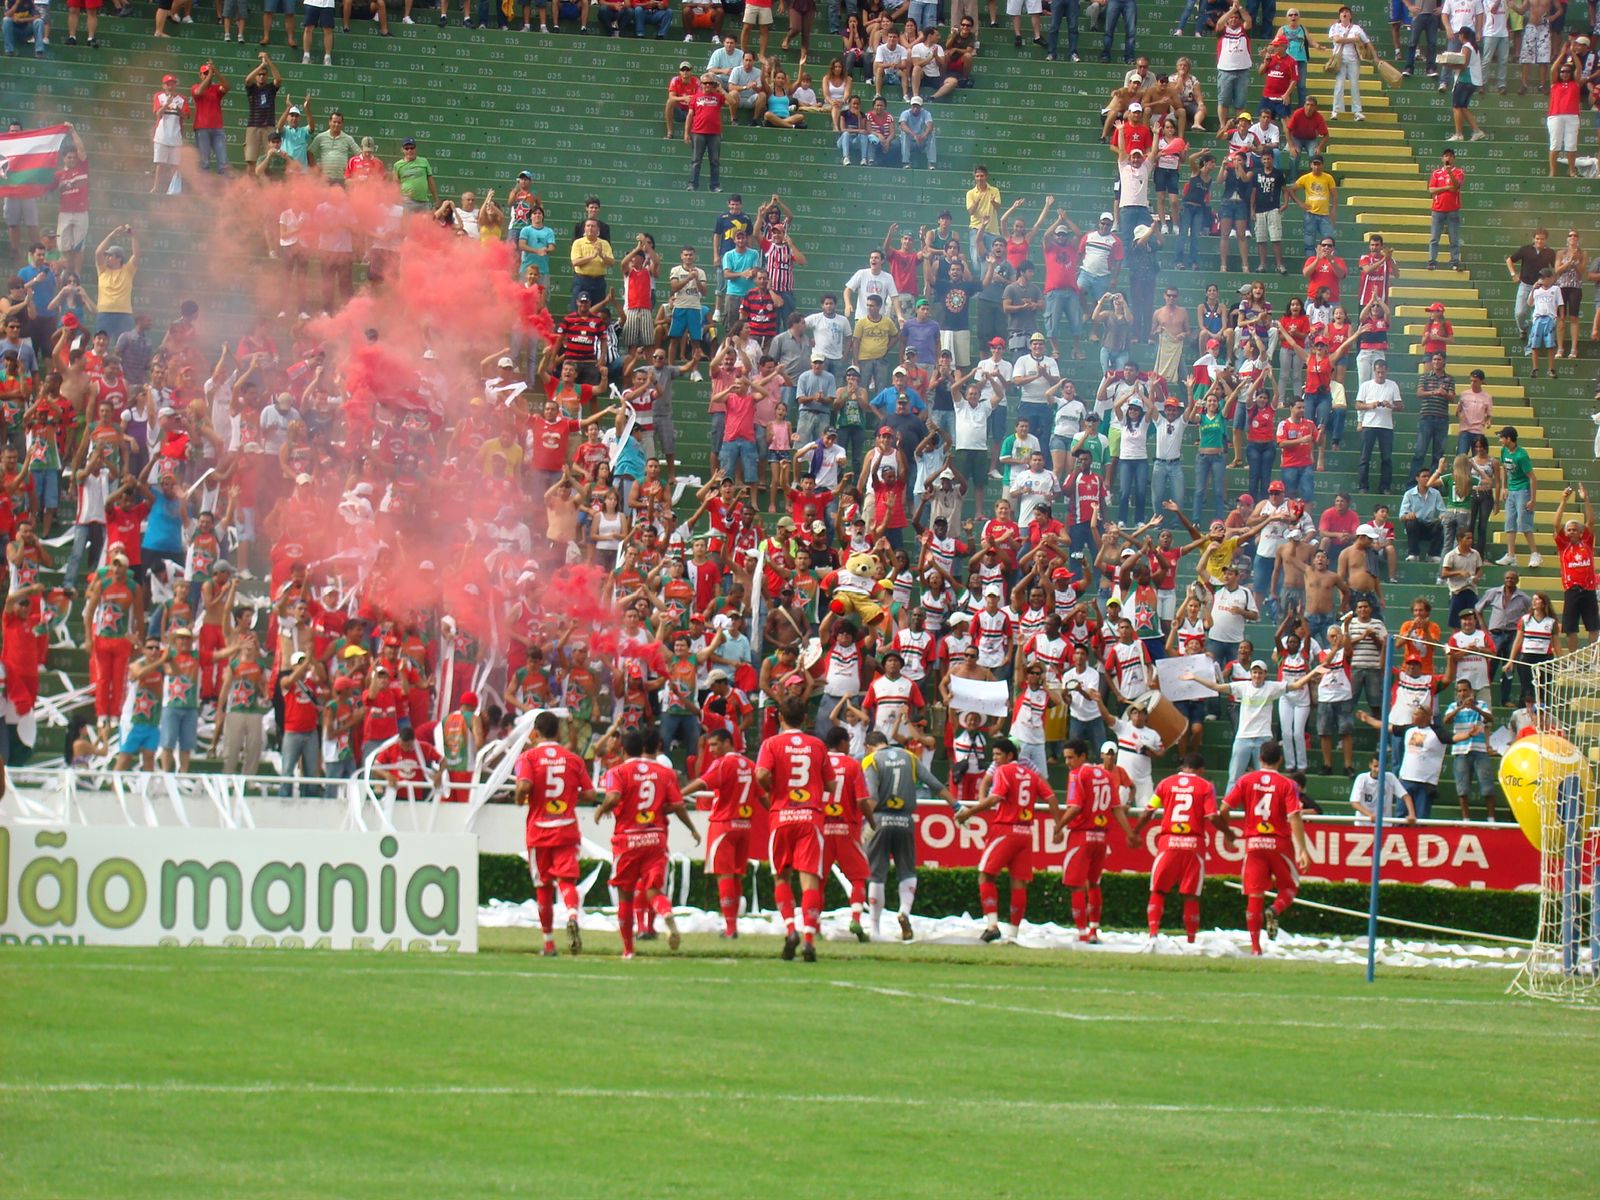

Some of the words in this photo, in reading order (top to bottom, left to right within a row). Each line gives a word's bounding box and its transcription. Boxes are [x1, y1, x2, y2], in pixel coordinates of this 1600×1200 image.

[545, 766, 566, 798] 5
[788, 755, 811, 787] 3
[893, 767, 901, 795] 1
[637, 780, 656, 811] 9
[738, 776, 753, 804] 7
[1018, 781, 1031, 807] 6
[1092, 785, 1111, 813] 10
[1171, 794, 1193, 822] 2
[1254, 793, 1273, 821] 4
